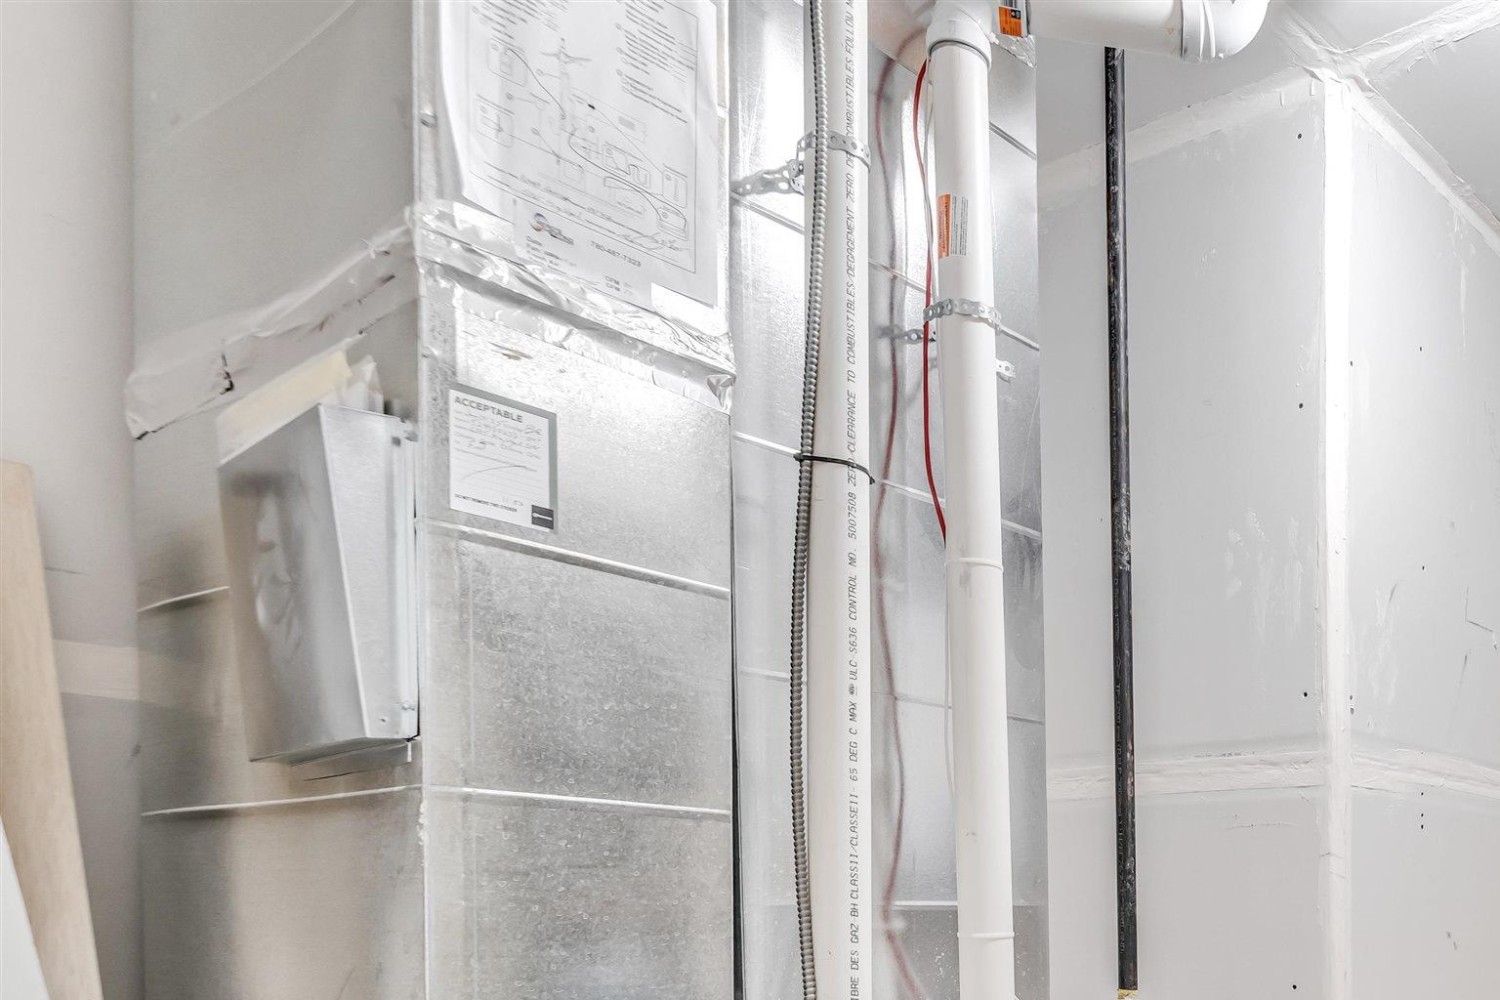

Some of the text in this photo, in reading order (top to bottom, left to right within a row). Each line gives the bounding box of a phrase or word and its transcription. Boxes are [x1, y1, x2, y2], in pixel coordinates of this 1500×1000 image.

[846, 172, 855, 203] ZERO
[847, 370, 856, 384] TO
[454, 396, 523, 423] ACCEPTABLE
[848, 574, 857, 621] CONTROL
[848, 700, 857, 722] MAX
[849, 727, 857, 735] C
[849, 740, 858, 763] DEG
[849, 767, 858, 782] 65
[850, 949, 859, 970] DES
